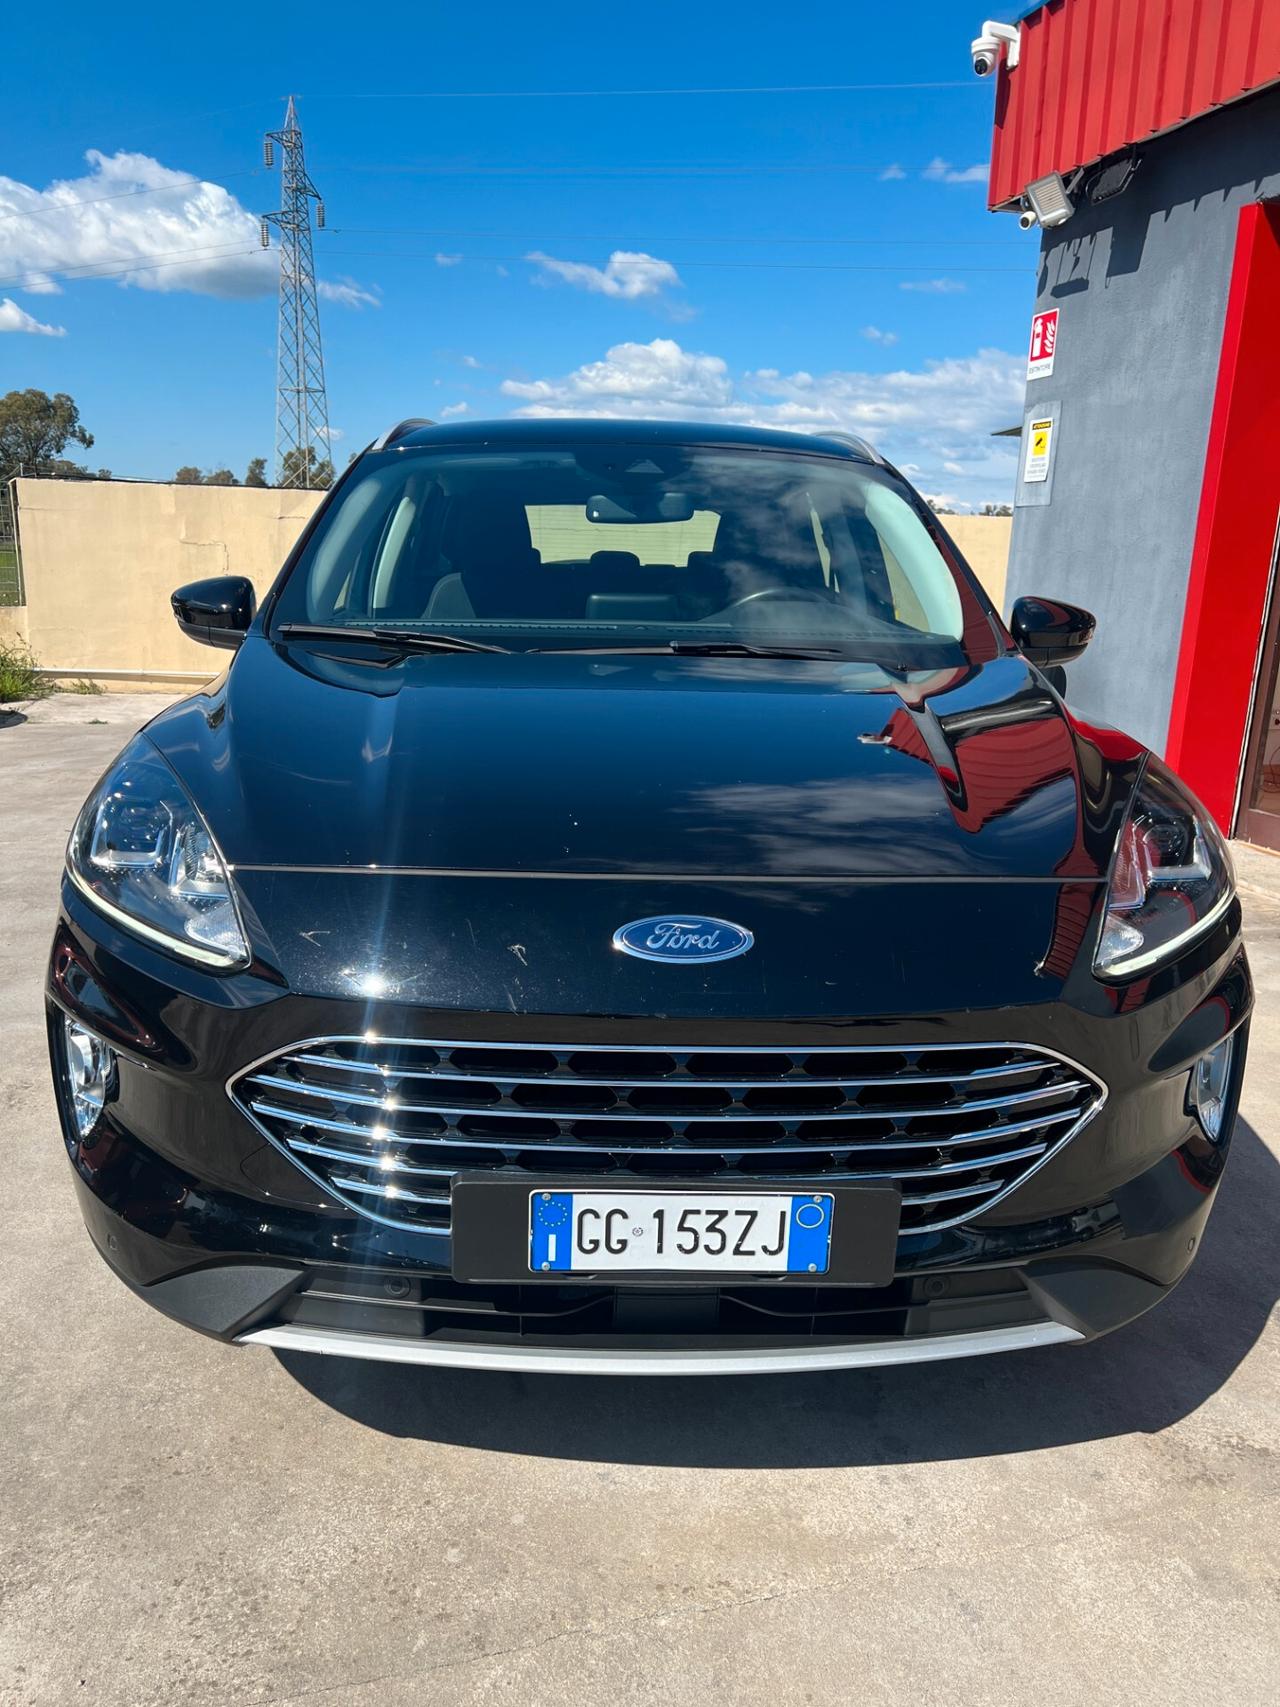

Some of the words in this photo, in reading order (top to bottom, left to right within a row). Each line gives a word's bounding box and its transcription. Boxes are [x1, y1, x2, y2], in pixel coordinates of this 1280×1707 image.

[646, 922, 720, 950] Ford
[576, 1208, 628, 1255] GG
[652, 1208, 787, 1256] 153ZJ
